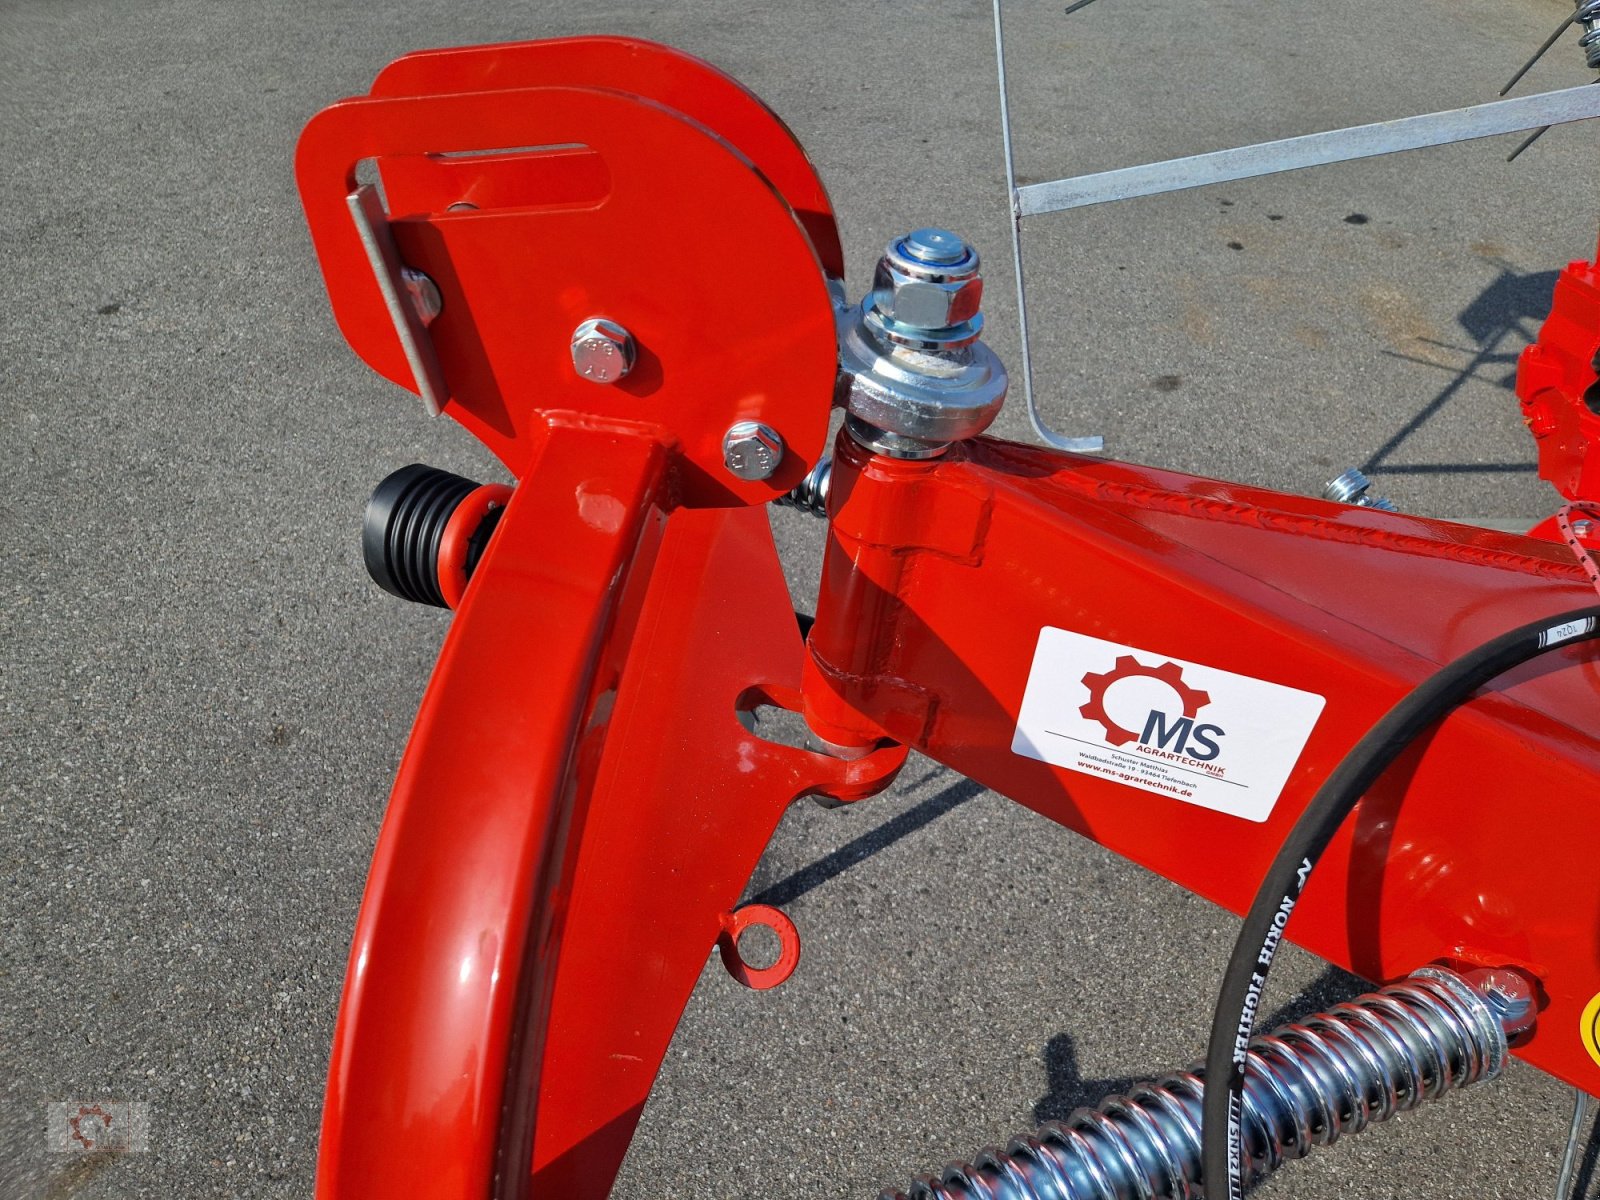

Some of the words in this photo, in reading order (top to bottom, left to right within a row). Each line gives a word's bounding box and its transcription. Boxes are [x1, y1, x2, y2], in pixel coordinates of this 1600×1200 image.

[1139, 709, 1226, 761] MS
[1111, 753, 1140, 767] Schuster
[1140, 761, 1169, 775] Matthias
[1128, 765, 1136, 773] 19
[1140, 769, 1161, 780] 93464
[1161, 774, 1198, 789] Tiefenbach
[1135, 745, 1226, 775] AGRARTECHNIK
[1077, 760, 1193, 798] www.ms-agrartechnik.de
[1257, 895, 1296, 966] NORTH
